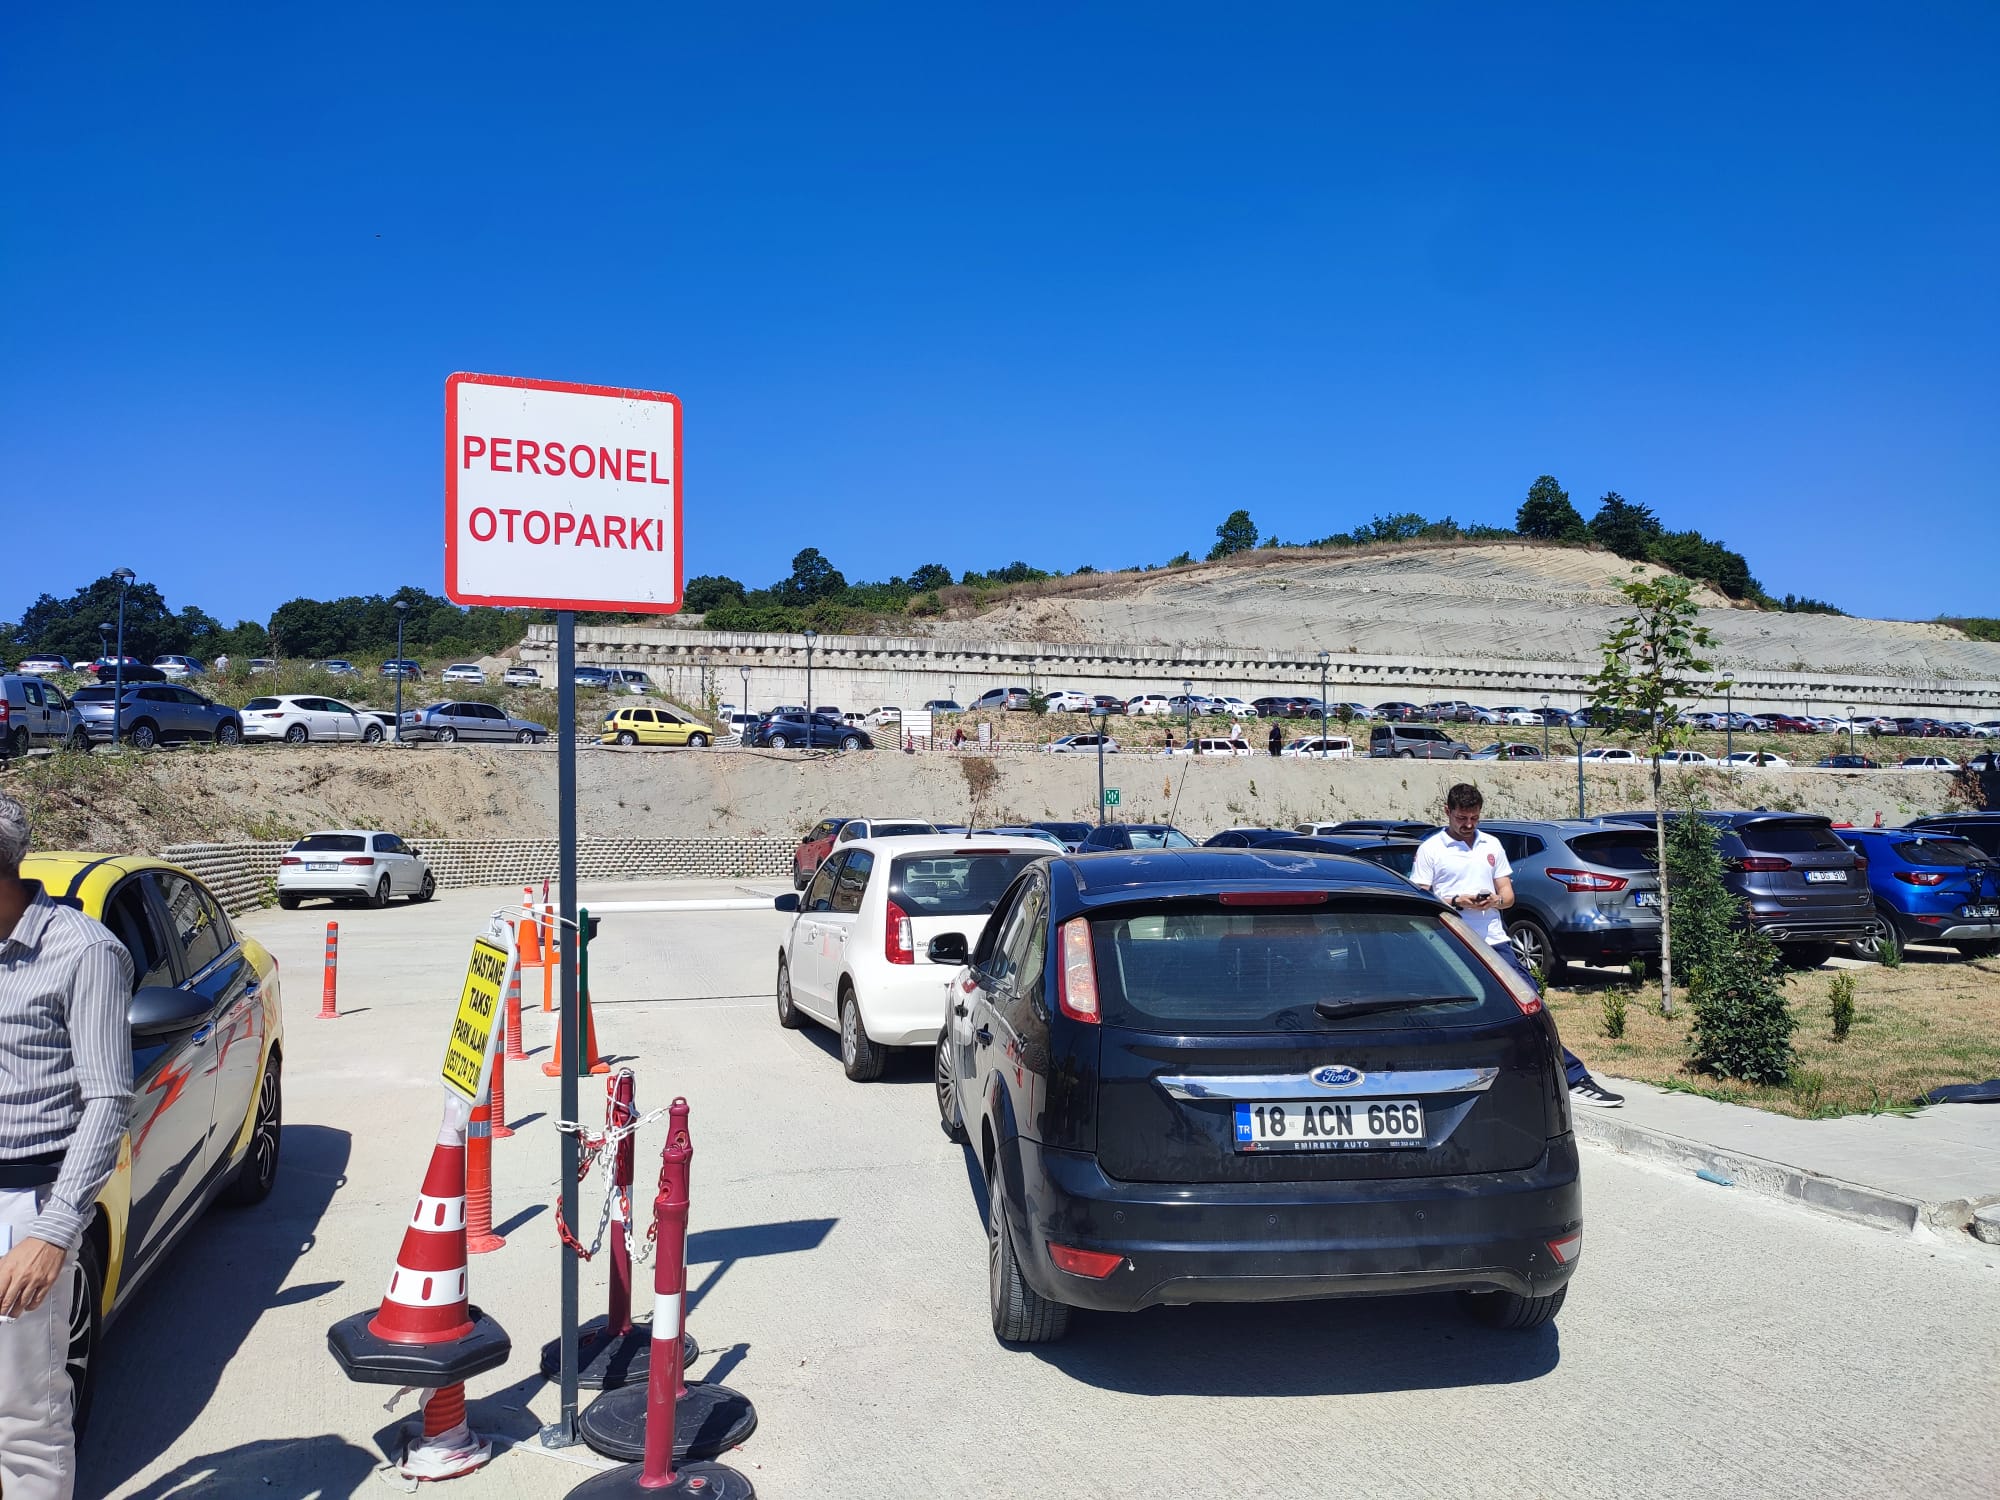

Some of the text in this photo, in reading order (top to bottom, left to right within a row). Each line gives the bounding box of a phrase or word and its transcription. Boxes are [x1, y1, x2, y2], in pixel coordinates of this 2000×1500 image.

[463, 435, 670, 485] PERSONEL
[468, 507, 664, 552] OTOPARKI
[470, 949, 506, 987] HASTANE
[454, 1018, 473, 1046] PARK
[1322, 1070, 1351, 1082] Ford
[1238, 1125, 1250, 1135] TR
[1254, 1104, 1420, 1137] 18 ACN 666
[1343, 1141, 1370, 1149] AUTO
